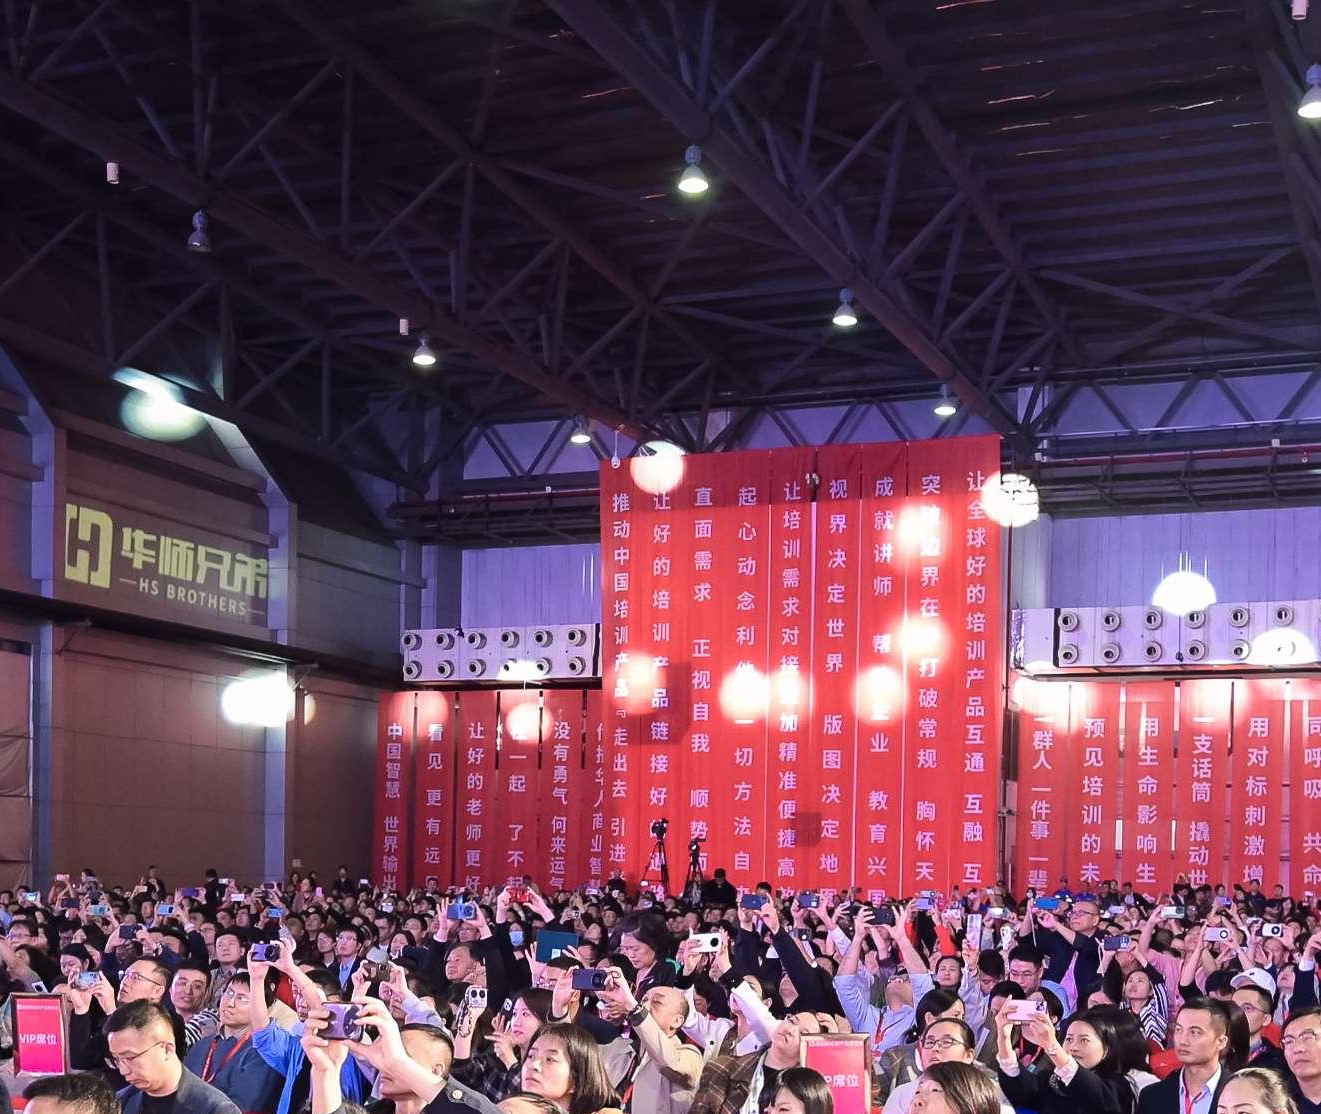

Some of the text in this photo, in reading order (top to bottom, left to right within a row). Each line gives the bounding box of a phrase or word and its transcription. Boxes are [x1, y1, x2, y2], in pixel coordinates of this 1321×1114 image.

[121, 527, 269, 598] 华师兄弟
[693, 487, 713, 602] 直面需求
[825, 479, 848, 673] 视界决定世界
[873, 476, 894, 597] 成就讲师
[139, 577, 247, 616] HS BROTHERS
[690, 638, 712, 753] 正视自我
[385, 723, 403, 799] 中国智慧
[552, 721, 571, 806] 没有勇气
[1029, 786, 1052, 840] 一件事
[19, 1033, 58, 1045] VIP席位
